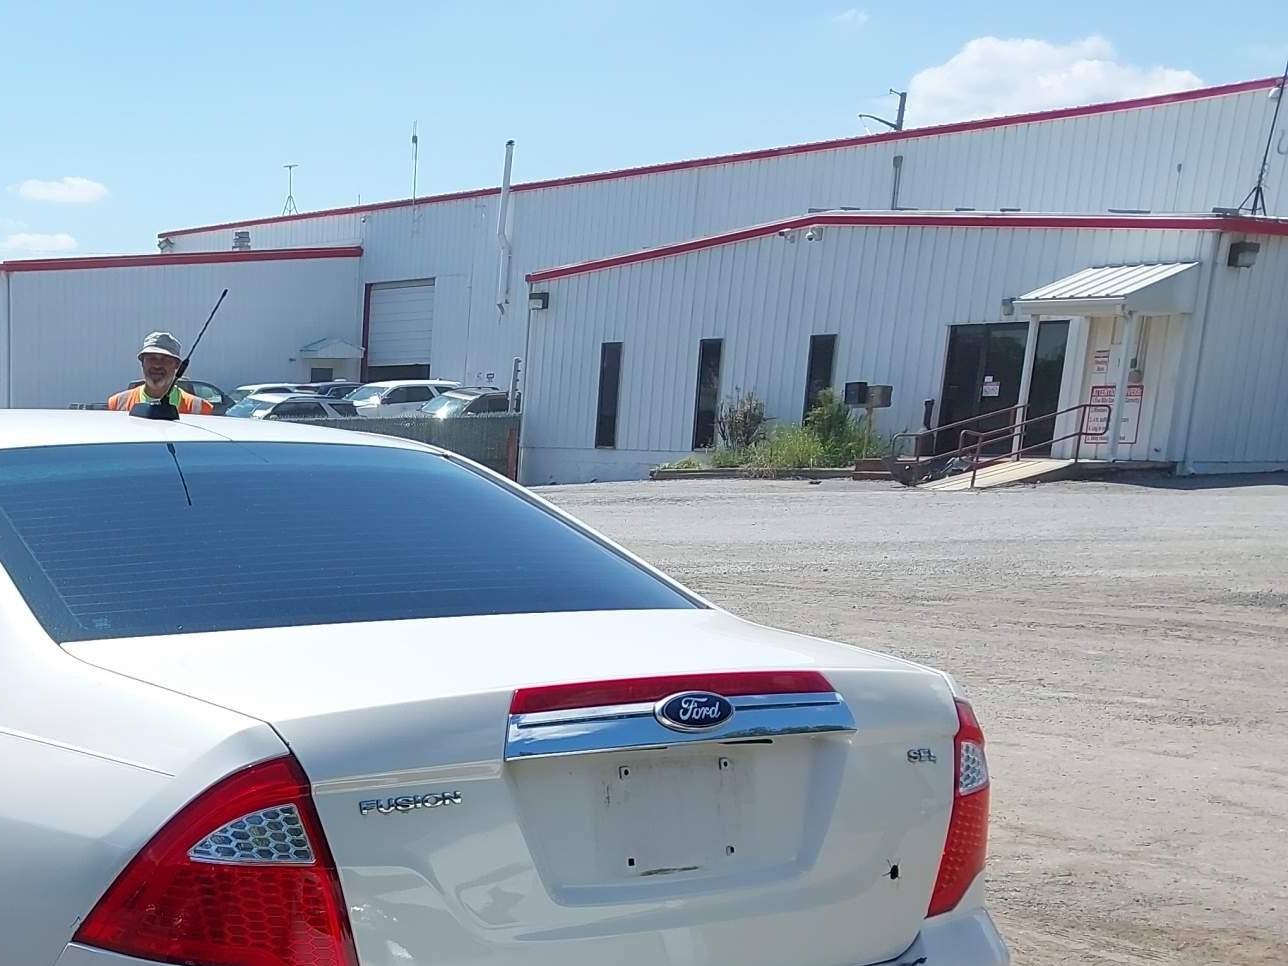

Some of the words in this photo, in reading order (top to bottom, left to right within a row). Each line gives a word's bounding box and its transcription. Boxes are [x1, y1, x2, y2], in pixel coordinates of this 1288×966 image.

[679, 697, 721, 721] Ford
[906, 748, 937, 764] SEL
[359, 790, 463, 816] FUSION
